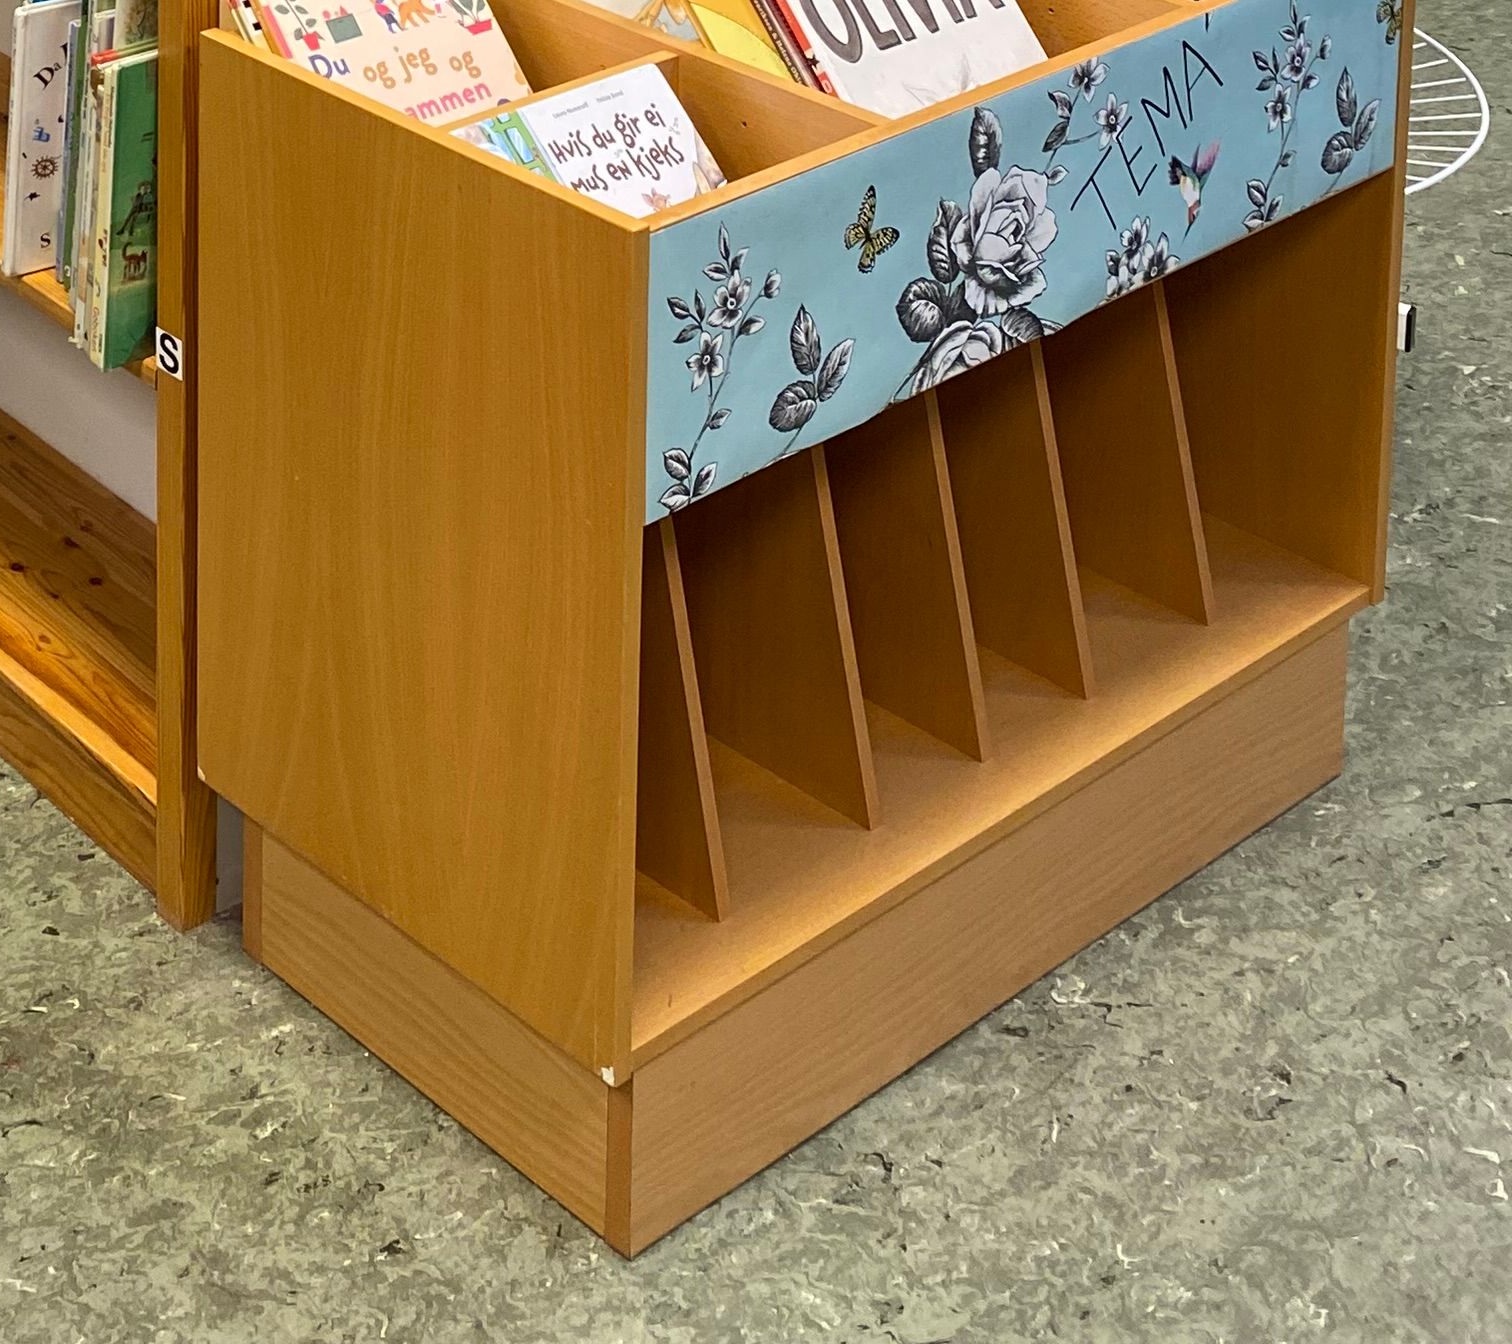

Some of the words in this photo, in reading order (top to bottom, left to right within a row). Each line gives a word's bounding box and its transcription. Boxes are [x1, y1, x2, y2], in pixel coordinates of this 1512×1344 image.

[308, 53, 351, 81] Du
[362, 61, 396, 90] og
[392, 46, 438, 84] jeg
[449, 49, 482, 79] og
[592, 123, 616, 150] du
[613, 112, 642, 148] gir
[646, 102, 668, 128] ei
[1070, 40, 1225, 231] TEMA
[633, 135, 686, 182] kjeks
[39, 231, 51, 250] S
[159, 331, 179, 375] S
